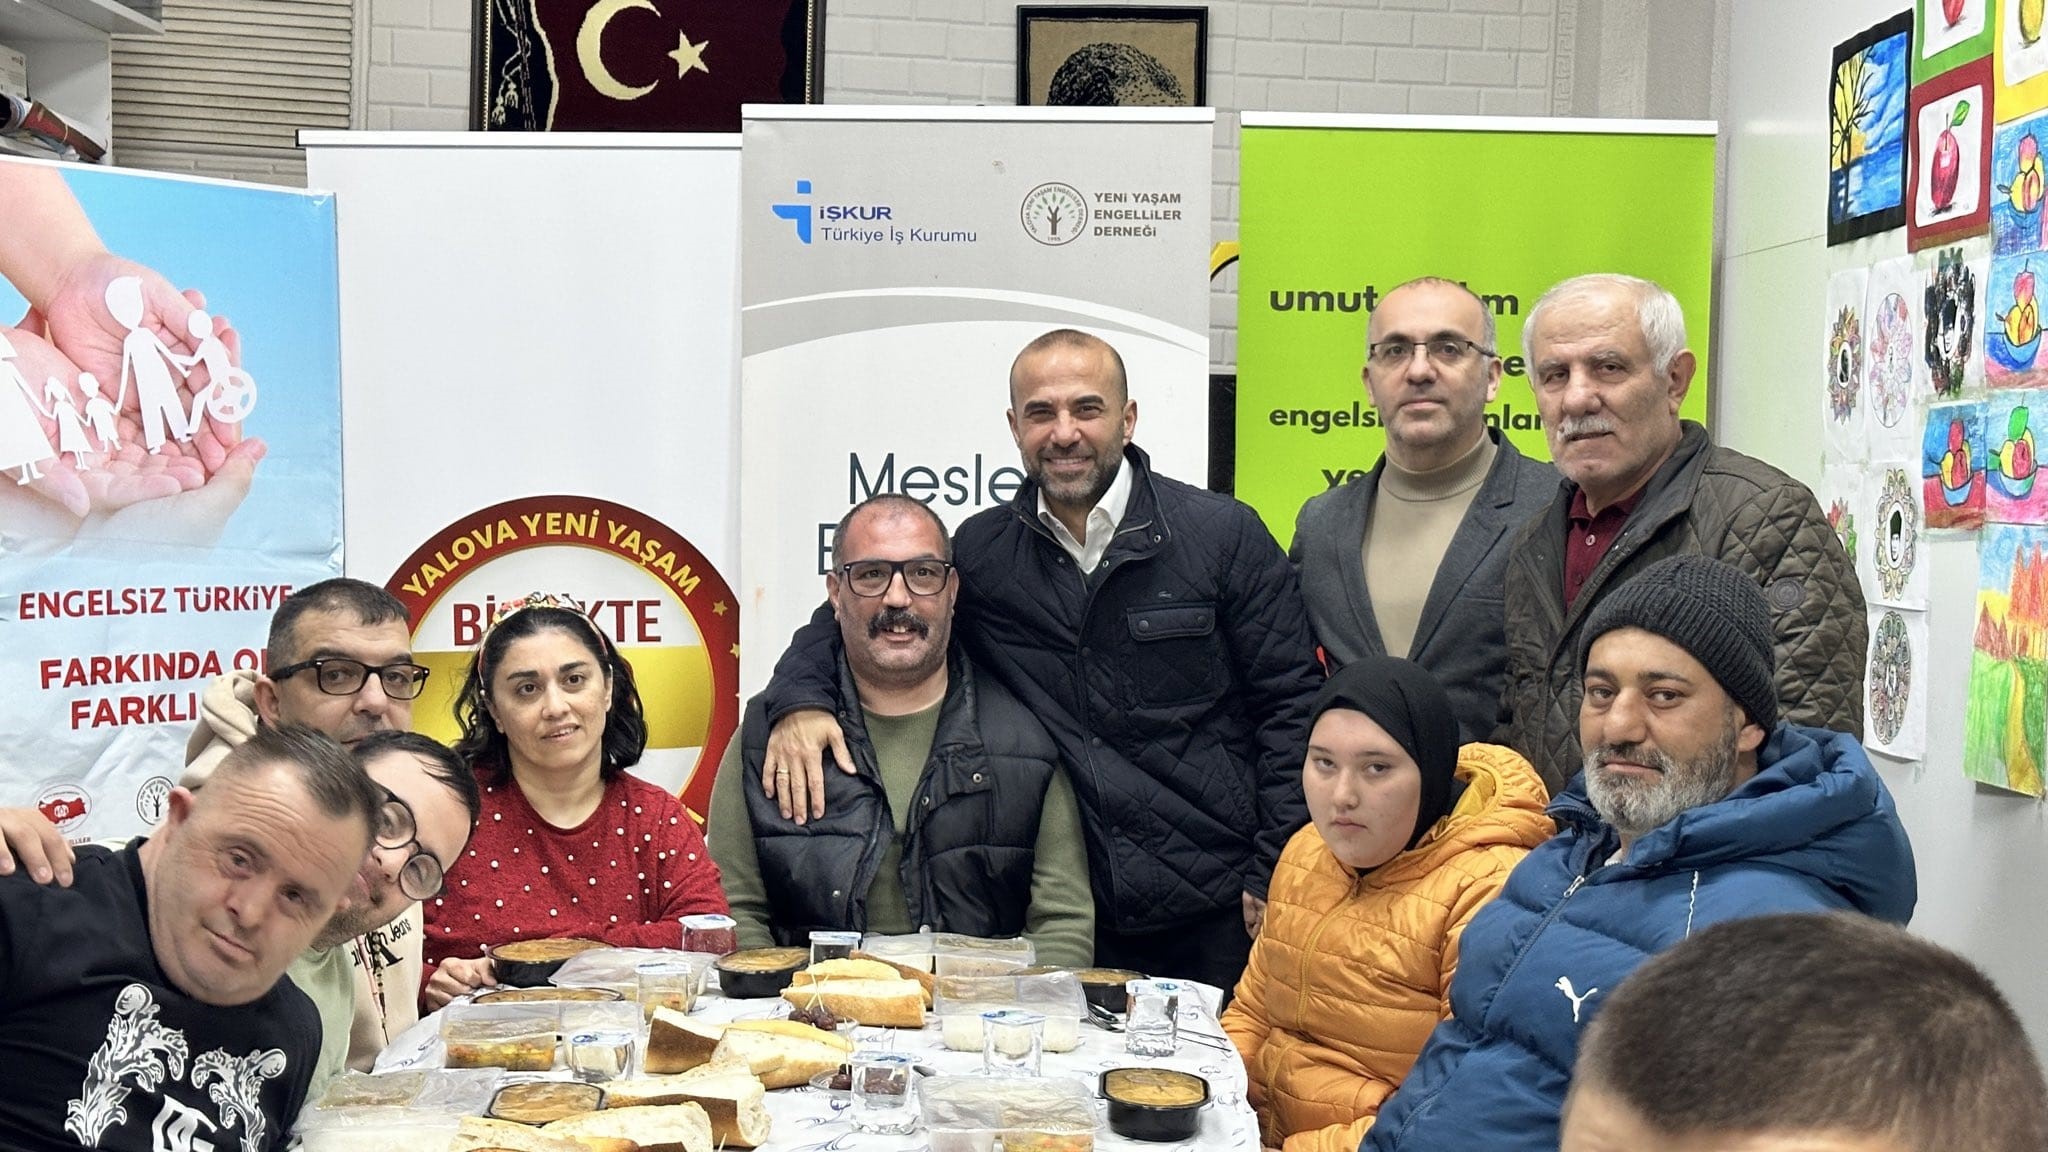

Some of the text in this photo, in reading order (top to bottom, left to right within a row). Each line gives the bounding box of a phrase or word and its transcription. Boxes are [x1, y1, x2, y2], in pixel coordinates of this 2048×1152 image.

[1132, 193, 1182, 206] YAŞAM
[821, 226, 884, 244] Türkiye
[910, 228, 977, 242] Kurumu
[1270, 285, 1379, 313] umut
[402, 509, 702, 598] YALOVA YENİ YAŞAM
[40, 650, 223, 690] FARKINDA
[70, 692, 197, 730] FARKLI
